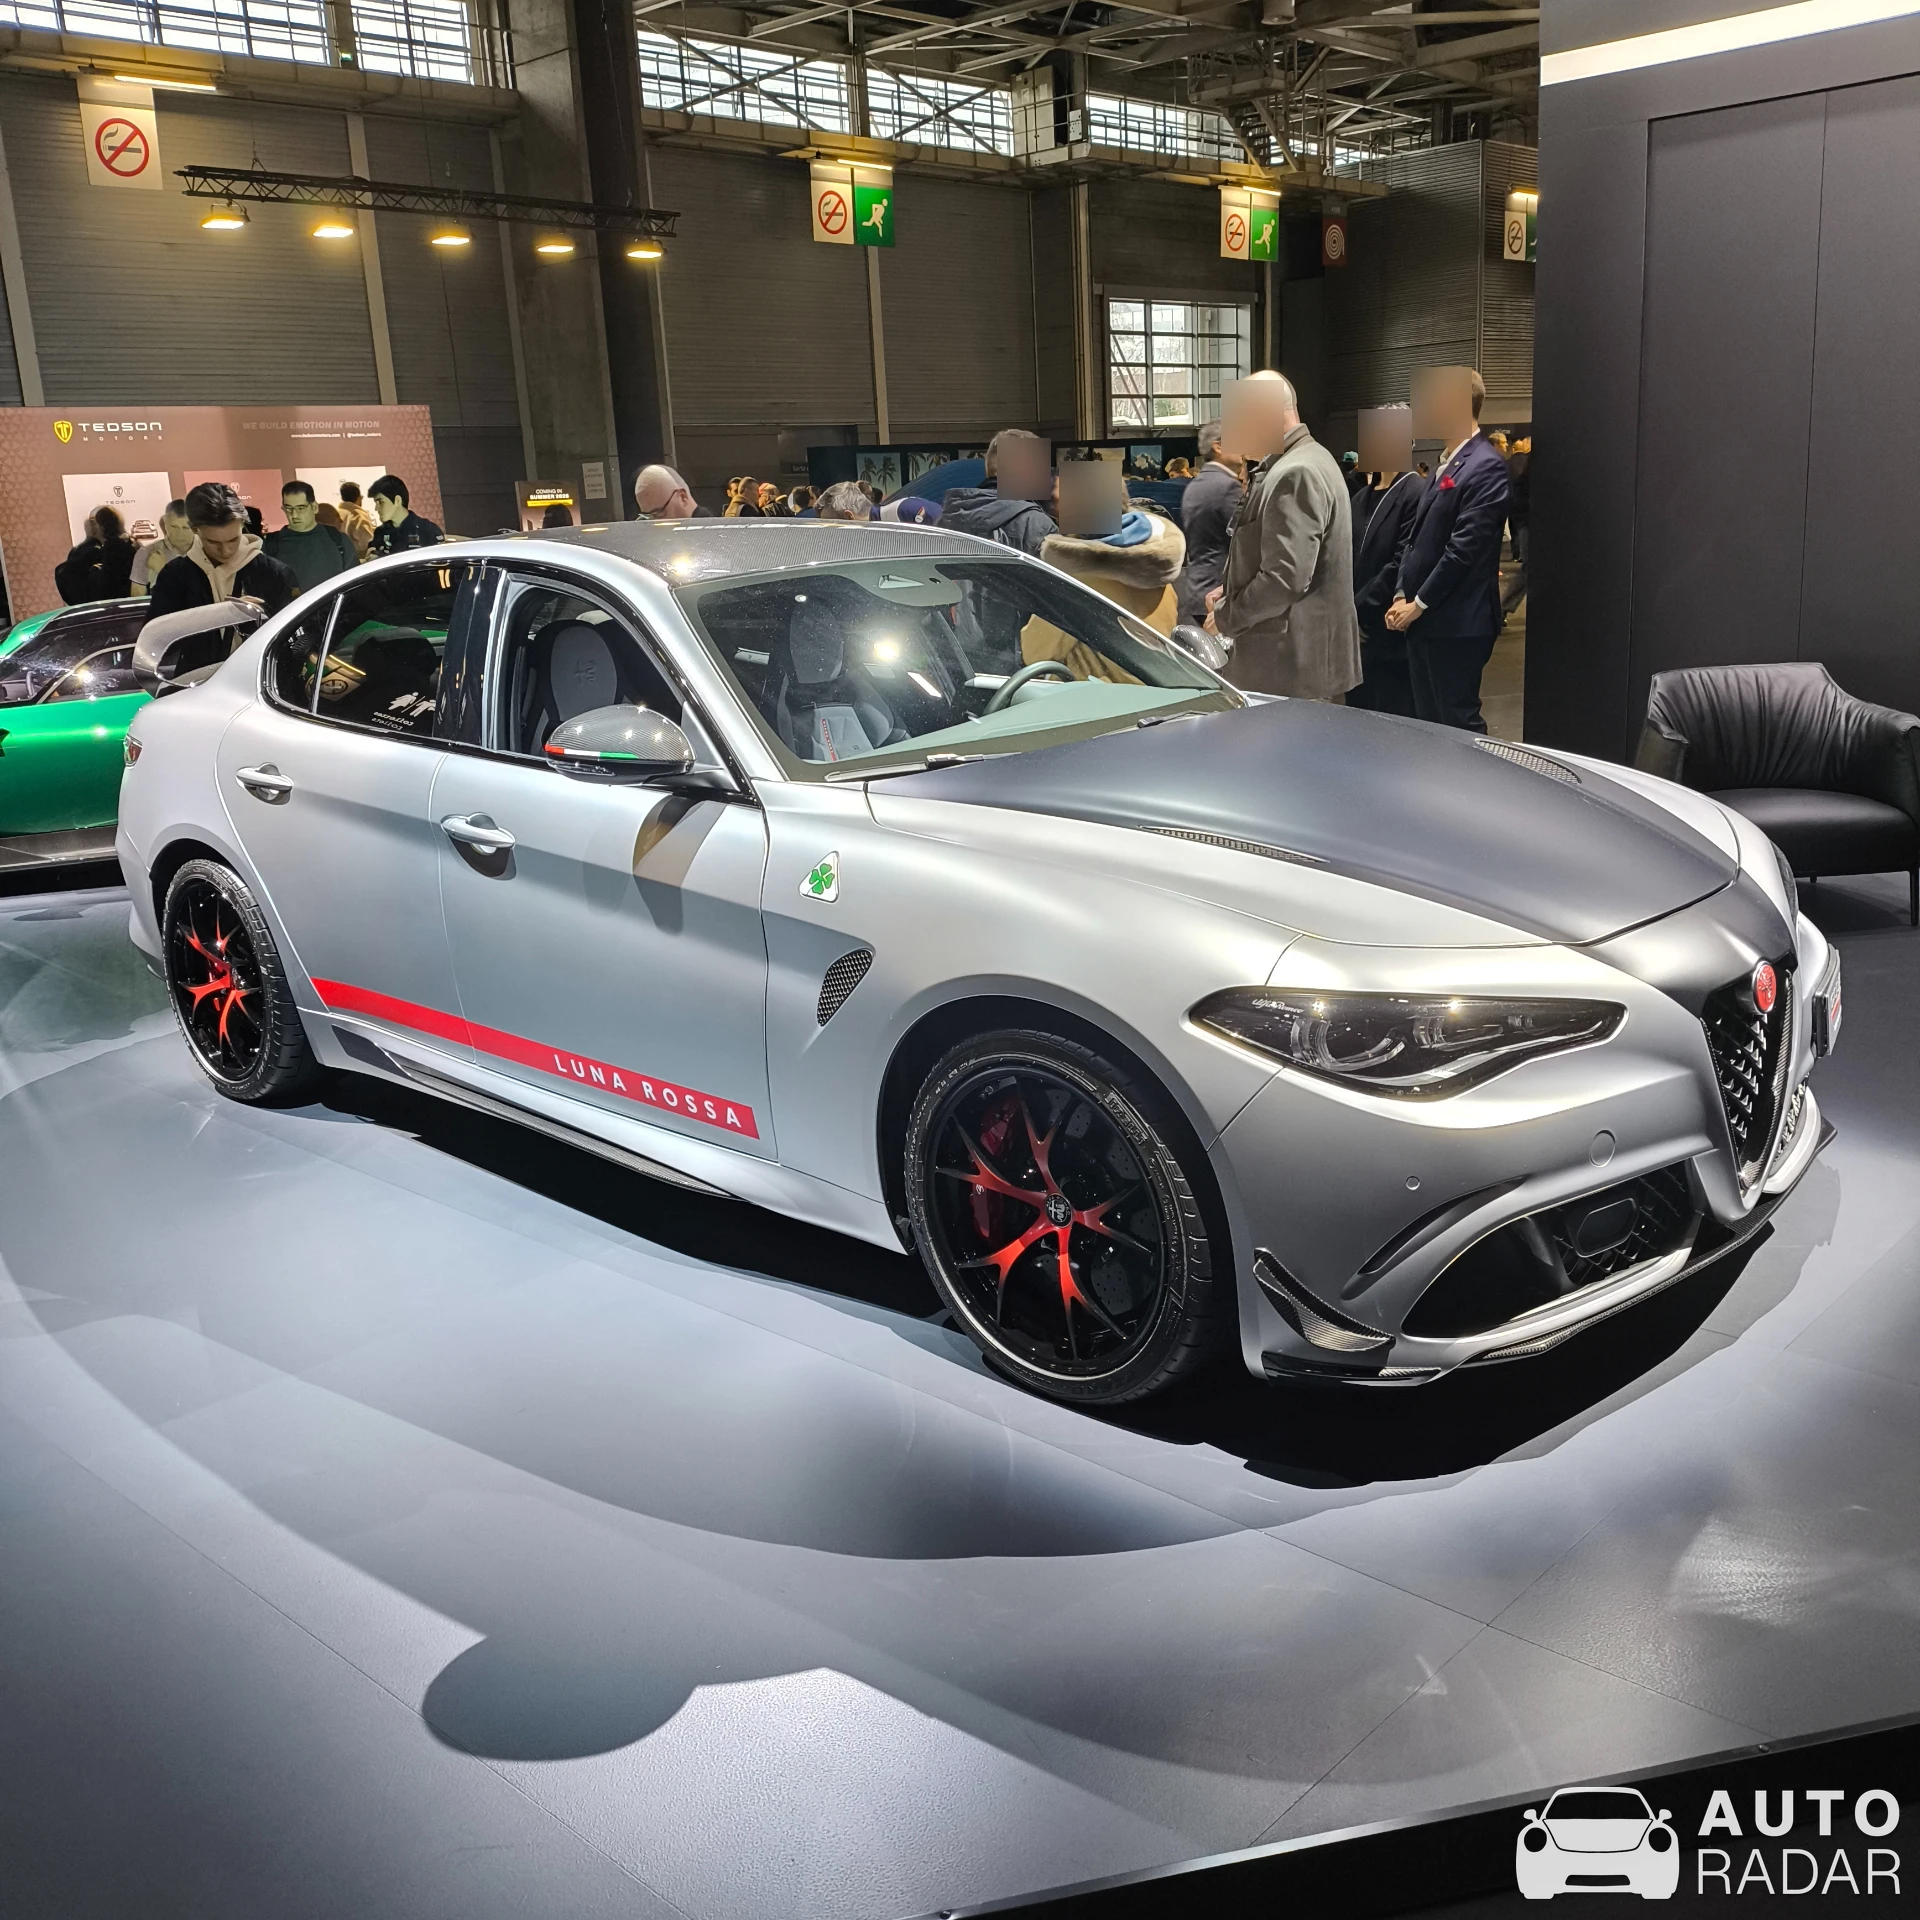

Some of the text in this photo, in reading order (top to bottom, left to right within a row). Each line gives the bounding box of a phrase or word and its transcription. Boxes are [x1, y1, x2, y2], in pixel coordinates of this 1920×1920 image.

[78, 422, 162, 432] TEDSON
[242, 420, 380, 430] WE BUILD EMOTION IN MOTION
[554, 1054, 742, 1128] LUNA ROSSA
